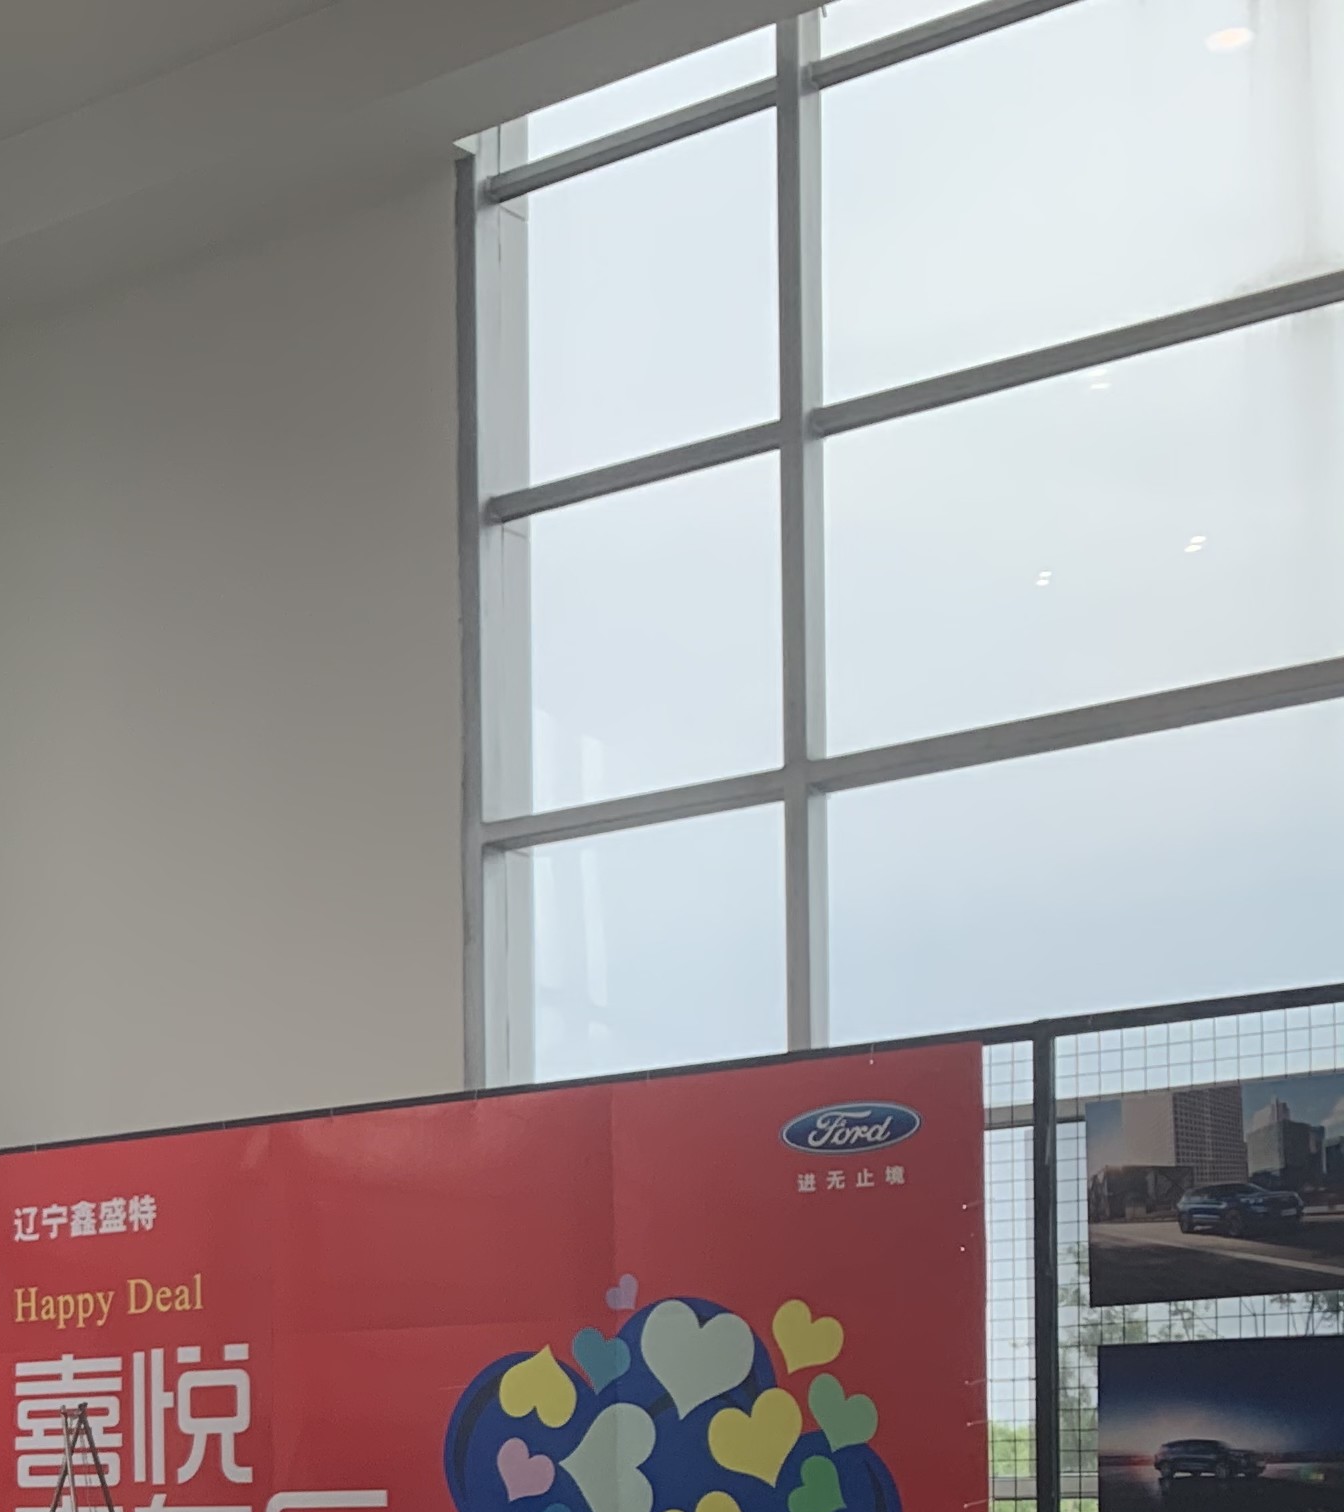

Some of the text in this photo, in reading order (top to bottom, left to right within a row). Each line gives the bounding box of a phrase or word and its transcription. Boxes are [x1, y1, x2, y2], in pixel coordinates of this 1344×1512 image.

[808, 1109, 894, 1148] Ford
[798, 1165, 905, 1192] 进无止境
[14, 1194, 157, 1242] 辽宁鑫盛特
[14, 1272, 204, 1329] Happy Deal
[14, 1343, 253, 1489] 喜悦
